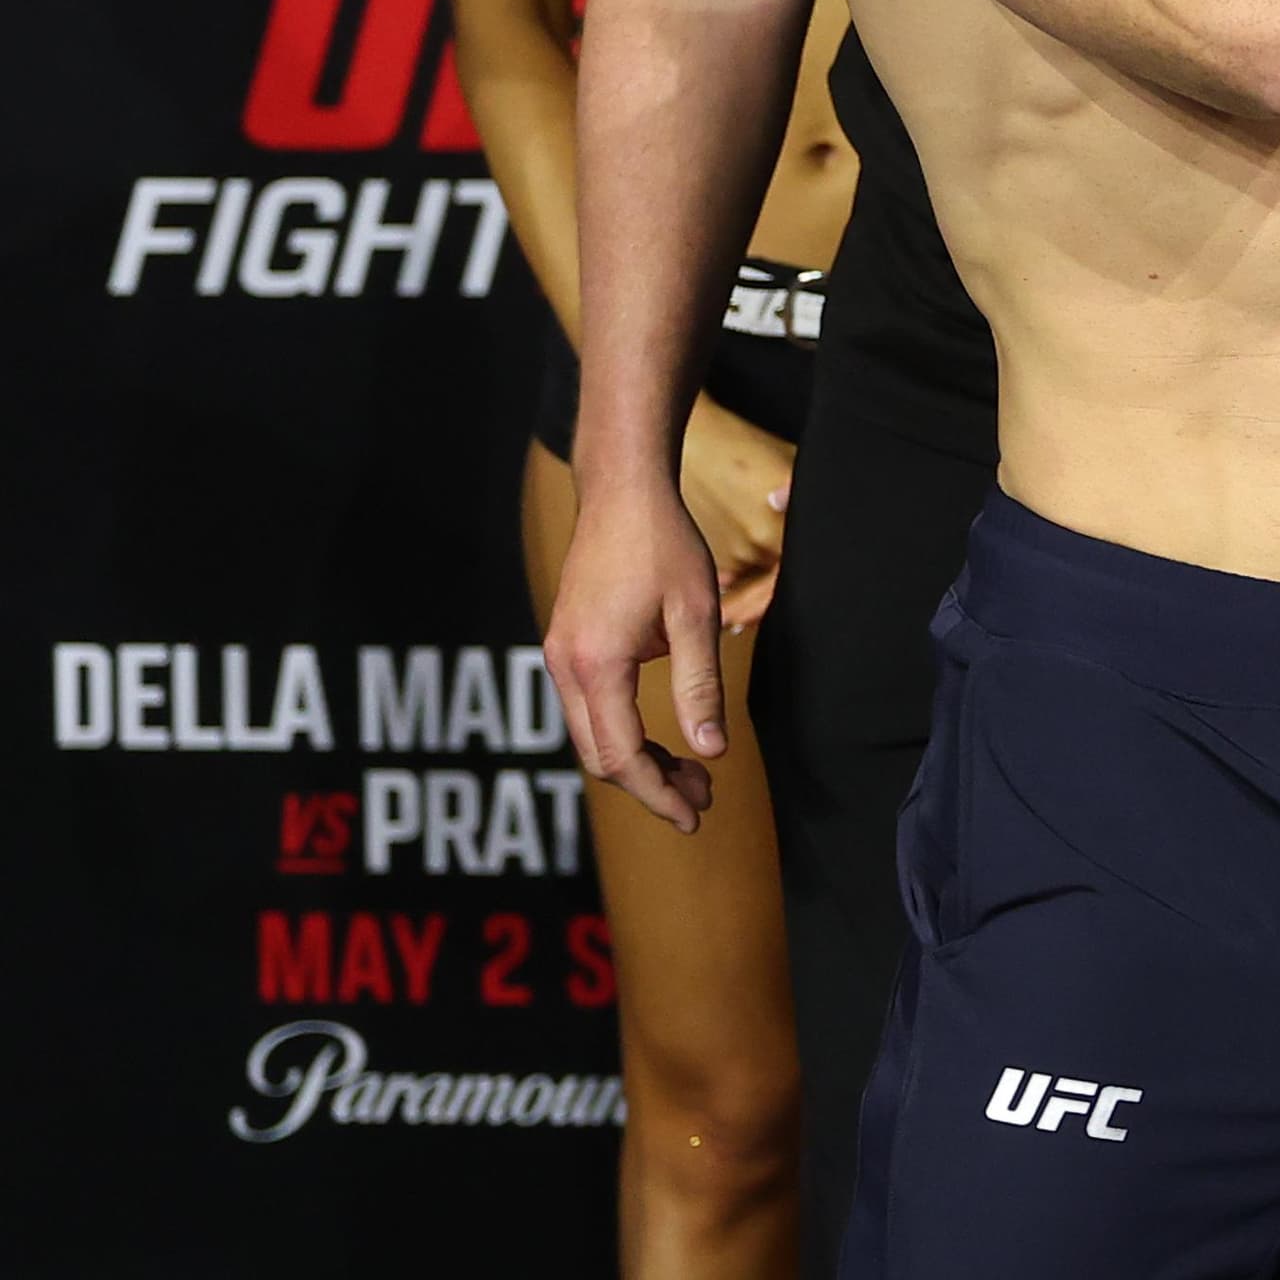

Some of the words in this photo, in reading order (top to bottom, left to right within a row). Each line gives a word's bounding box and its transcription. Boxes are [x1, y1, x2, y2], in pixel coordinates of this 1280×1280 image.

[106, 176, 510, 298] FIGHT
[52, 641, 336, 753] DELLA
[280, 790, 358, 857] VS
[361, 766, 585, 877] PRAT
[256, 908, 447, 1006] MAY
[478, 911, 535, 1008] 2
[984, 1066, 1144, 1143] UFC
